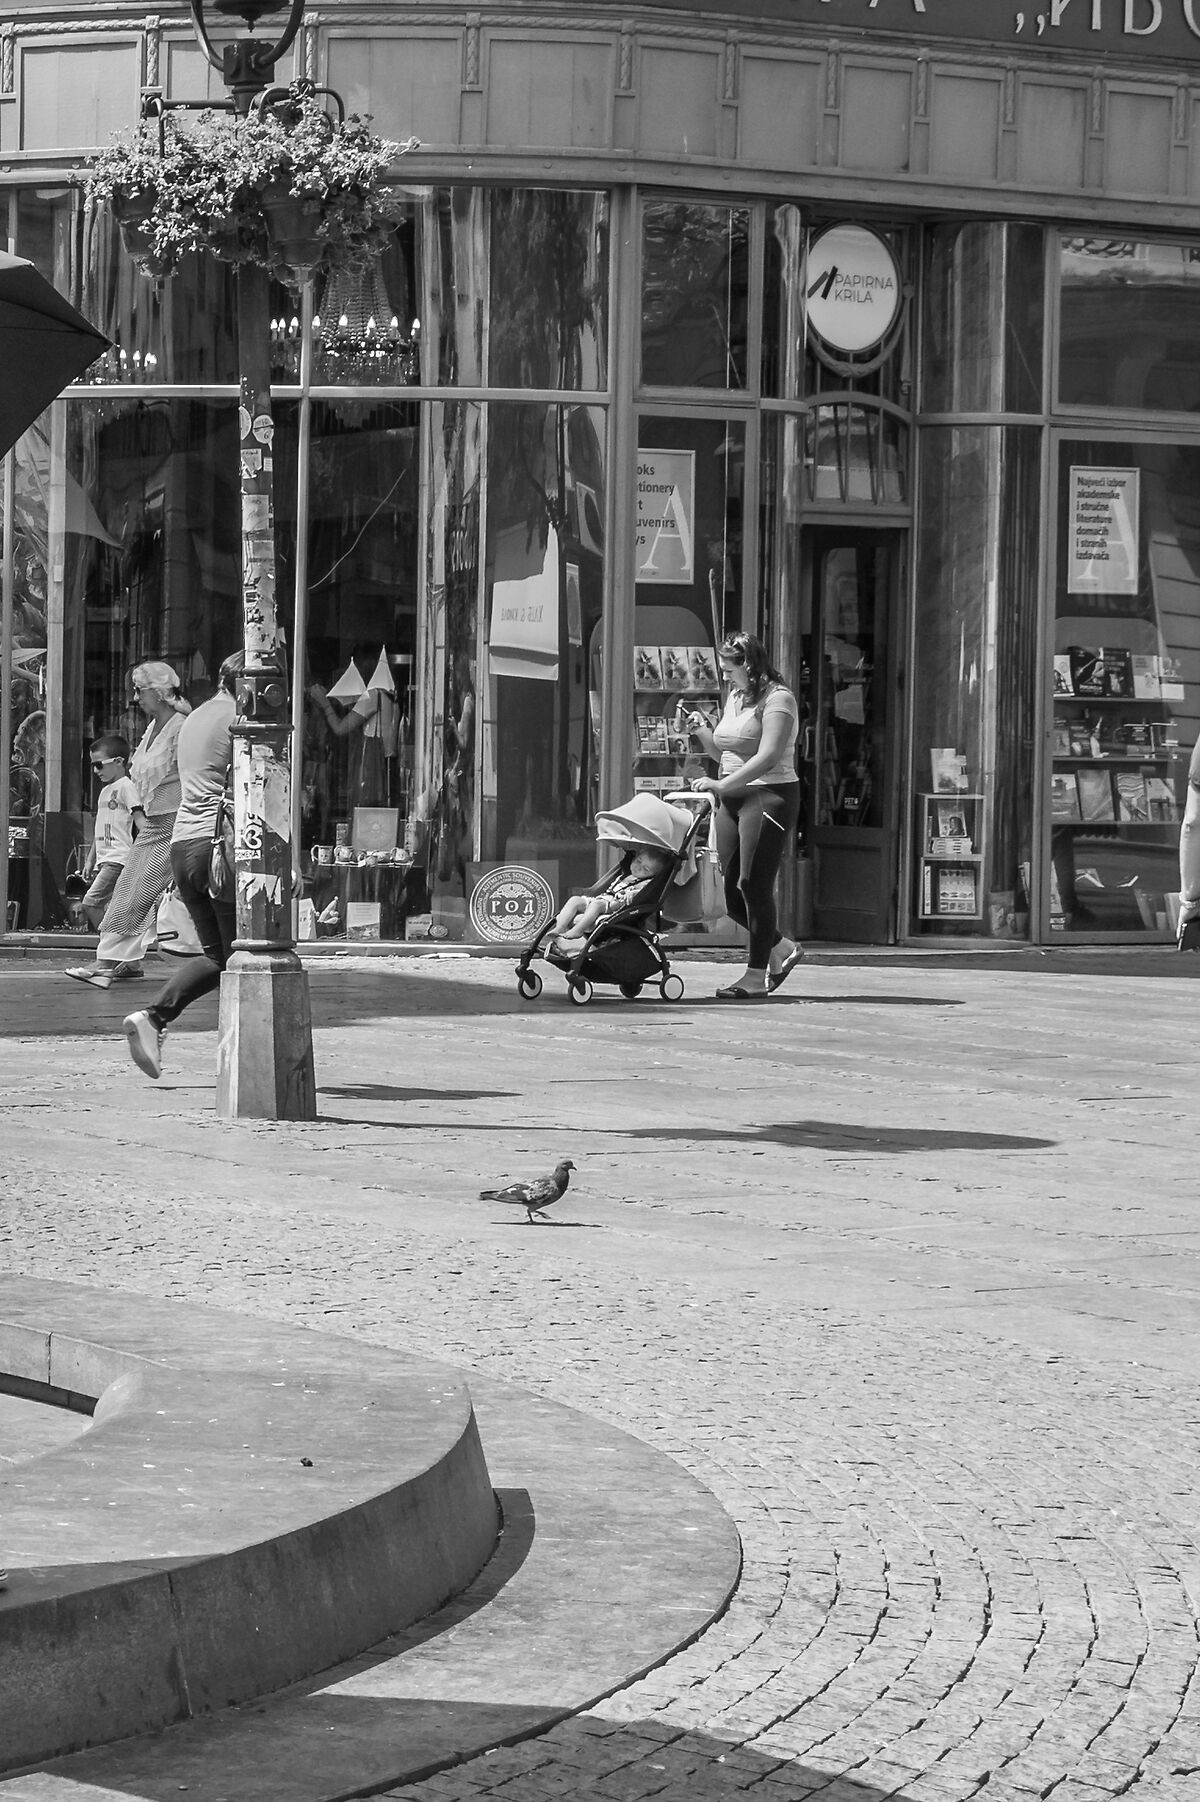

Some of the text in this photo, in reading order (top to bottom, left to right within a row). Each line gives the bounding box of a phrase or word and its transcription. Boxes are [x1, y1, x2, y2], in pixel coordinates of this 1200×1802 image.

[834, 273, 894, 290] PAPIRNA
[834, 288, 874, 304] KRILA
[637, 464, 655, 476] oks
[638, 481, 675, 497] tionery
[1076, 513, 1113, 523] literature
